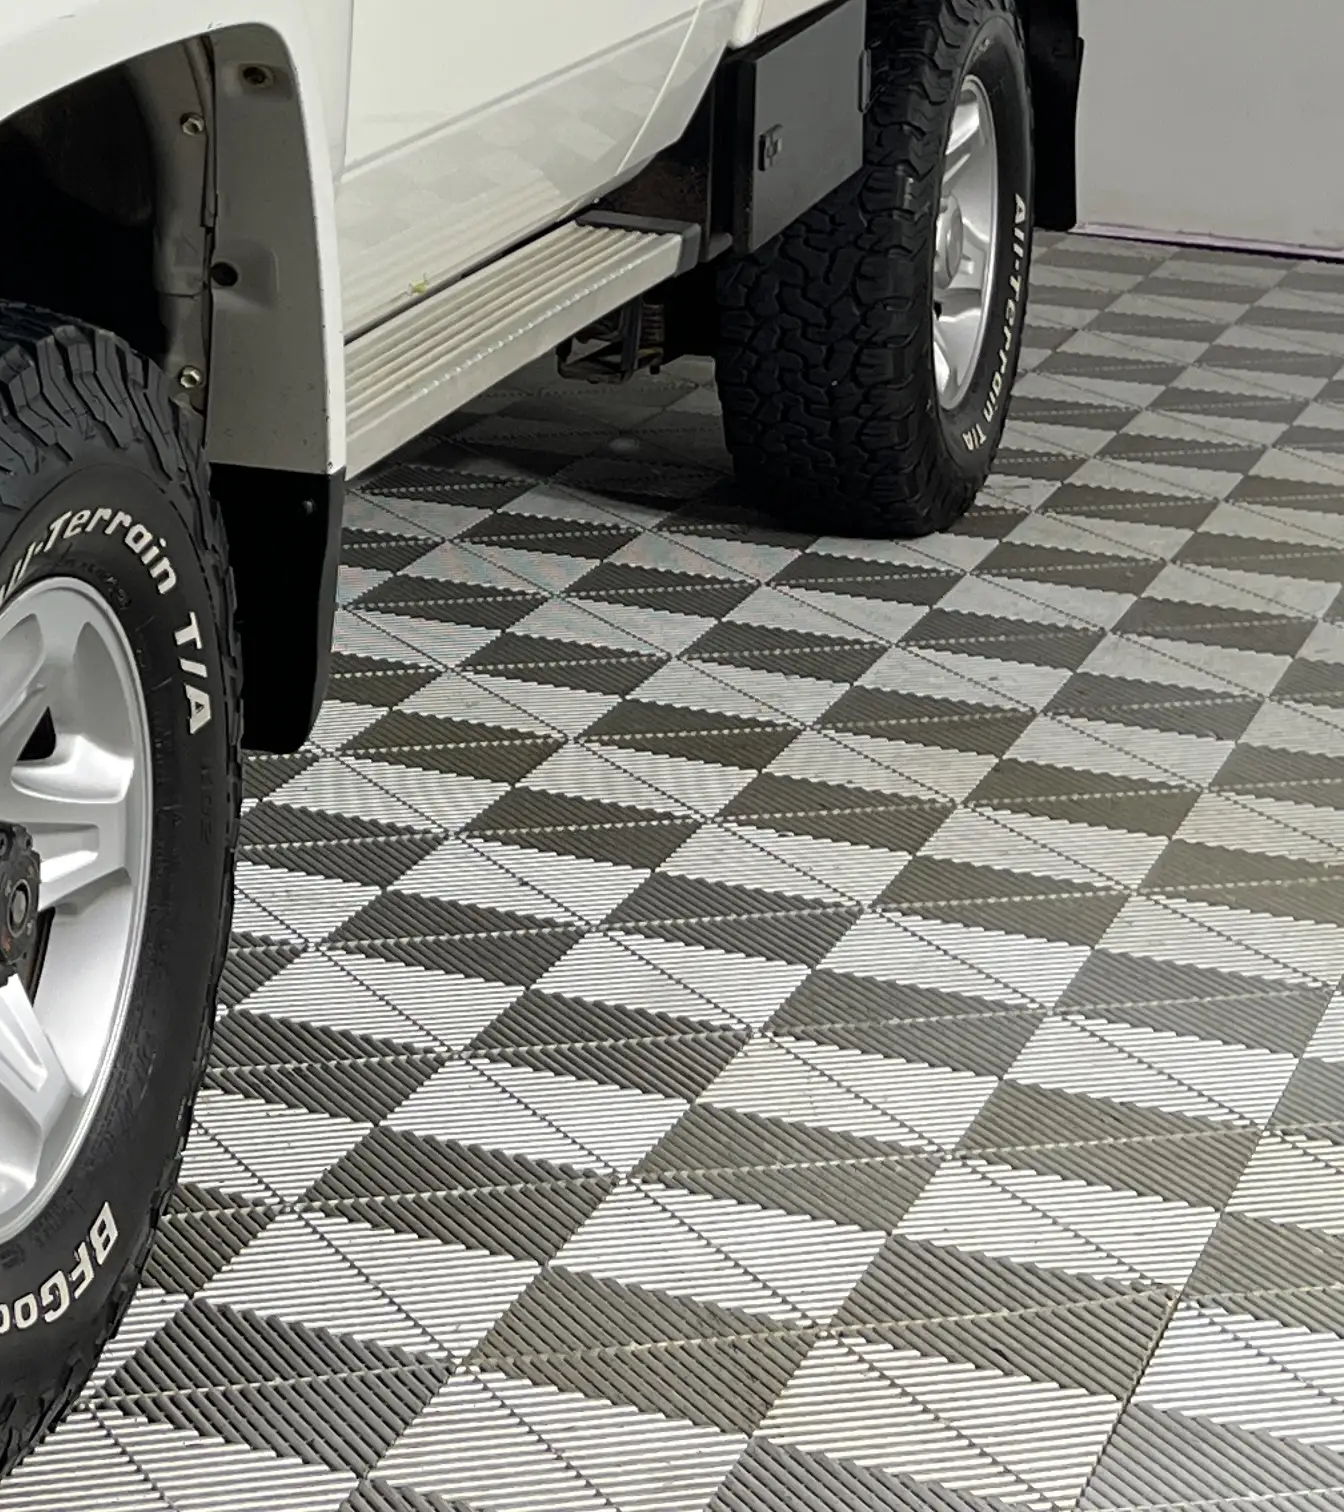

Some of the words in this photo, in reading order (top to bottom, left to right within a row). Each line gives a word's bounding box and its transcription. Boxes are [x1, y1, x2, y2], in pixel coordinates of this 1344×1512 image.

[983, 192, 1026, 422] All-Terrain
[962, 423, 987, 450] T/A
[174, 610, 212, 734] T/A
